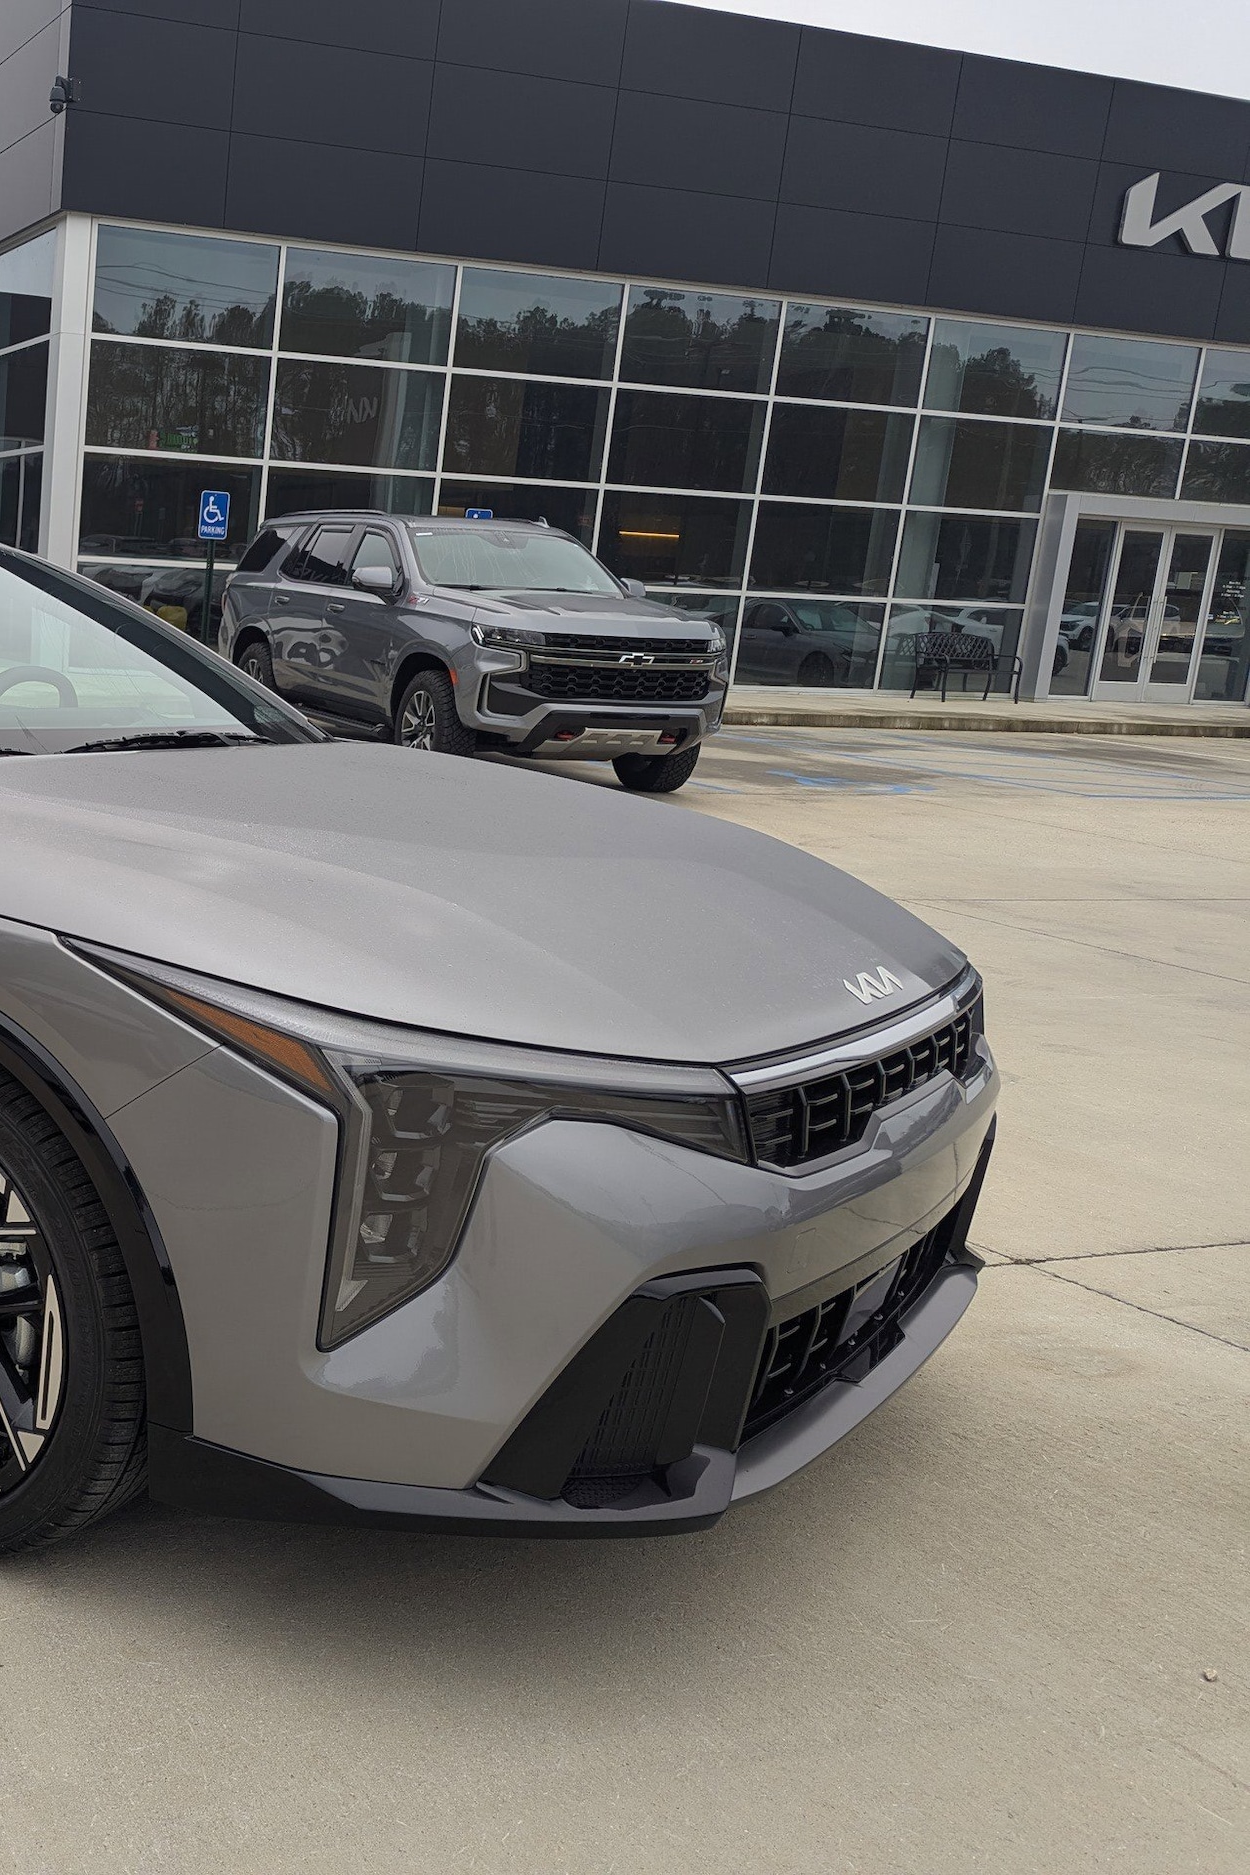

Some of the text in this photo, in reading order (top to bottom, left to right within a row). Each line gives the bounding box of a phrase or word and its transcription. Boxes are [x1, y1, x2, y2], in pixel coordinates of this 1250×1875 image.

[1118, 171, 1250, 260] KI
[200, 525, 225, 535] PARKING
[842, 965, 904, 1005] KIA
